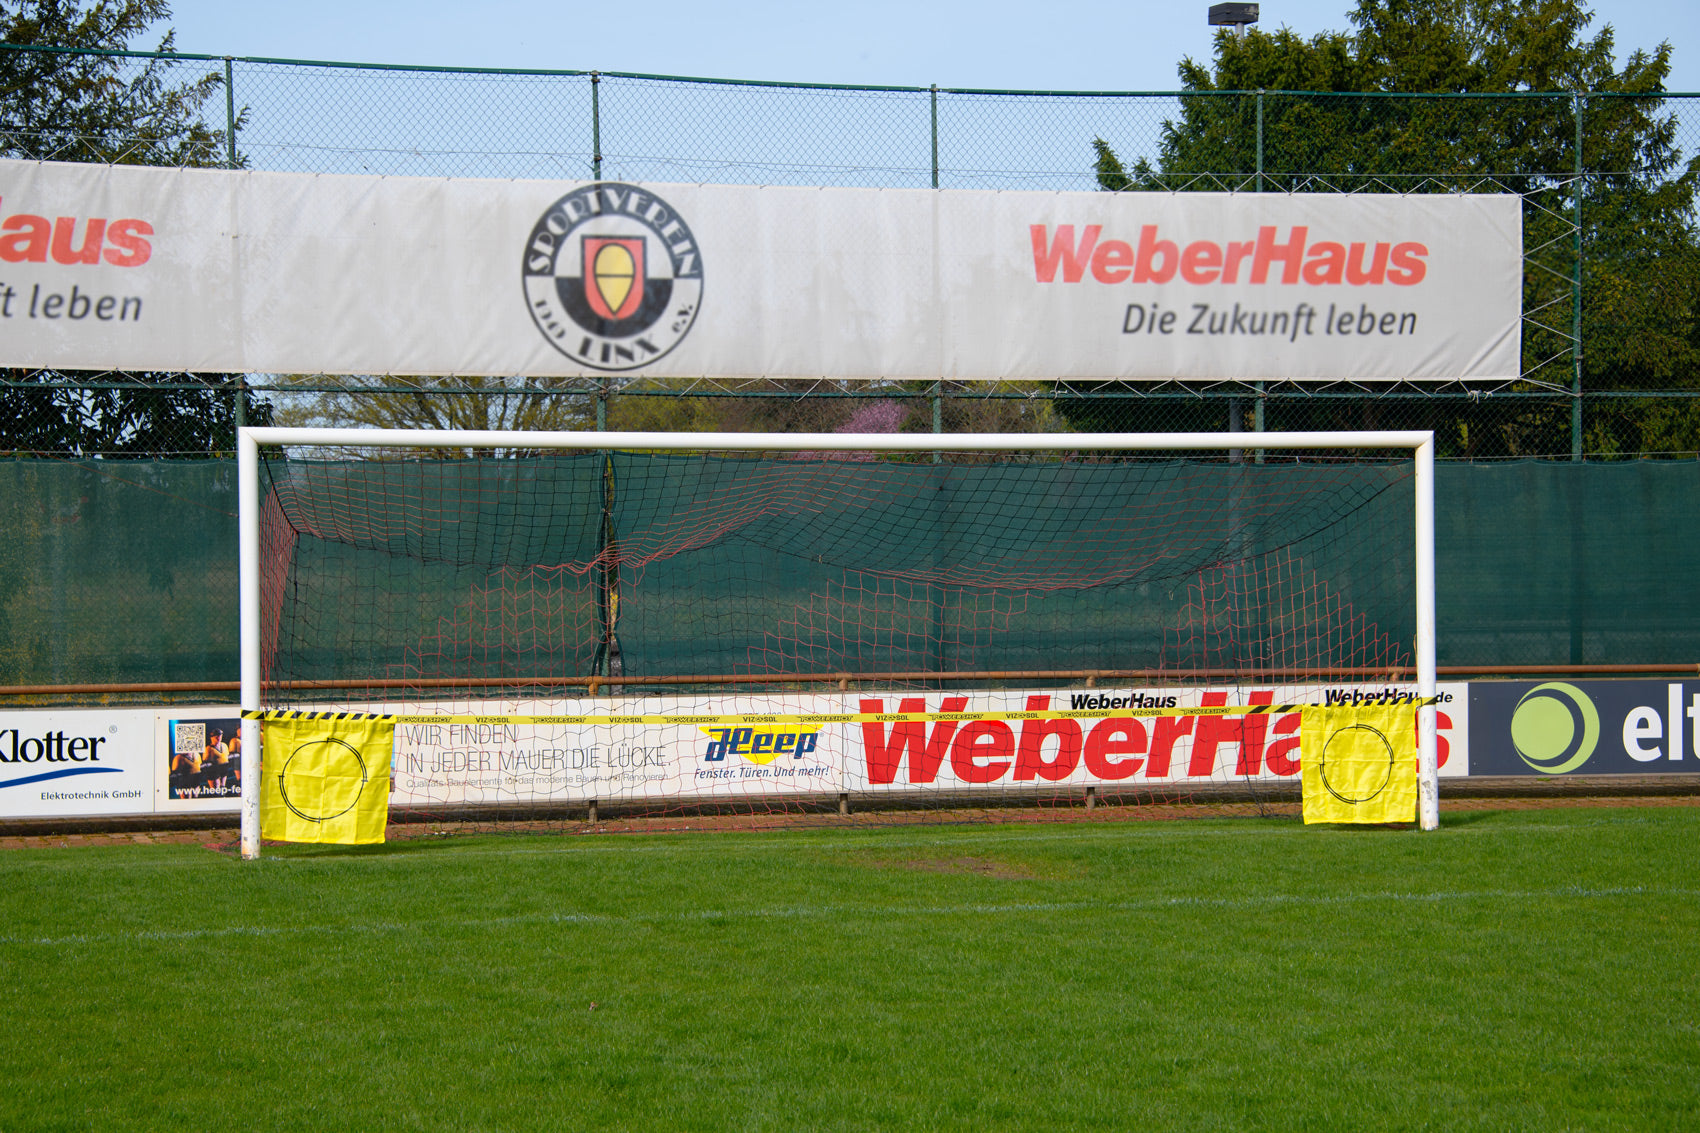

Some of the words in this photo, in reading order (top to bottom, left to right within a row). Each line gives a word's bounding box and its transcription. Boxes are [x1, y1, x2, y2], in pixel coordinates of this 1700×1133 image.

[0, 212, 154, 268] aus
[528, 188, 699, 277] SPORTVEREIN
[1029, 224, 1429, 287] WeberHaus
[28, 283, 142, 321] leben
[1122, 303, 1176, 336] Die
[1187, 302, 1316, 343] Zukunft
[1325, 303, 1418, 336] leben
[578, 333, 661, 364] LINX
[1071, 692, 1177, 710] WeberHaus
[405, 724, 442, 746] WIR
[450, 723, 517, 745] FINDEN
[405, 753, 424, 773] IN
[431, 751, 492, 773] JEDER
[500, 749, 566, 771] MAUER
[572, 748, 601, 769] DIE
[608, 743, 671, 769] LÜCKE.
[695, 767, 736, 779] Fenster.
[740, 766, 772, 778] Türen.
[774, 766, 795, 777] Und
[798, 765, 830, 777] mehr!
[41, 790, 109, 801] Elektrotechnik
[112, 789, 141, 799] GmbH
